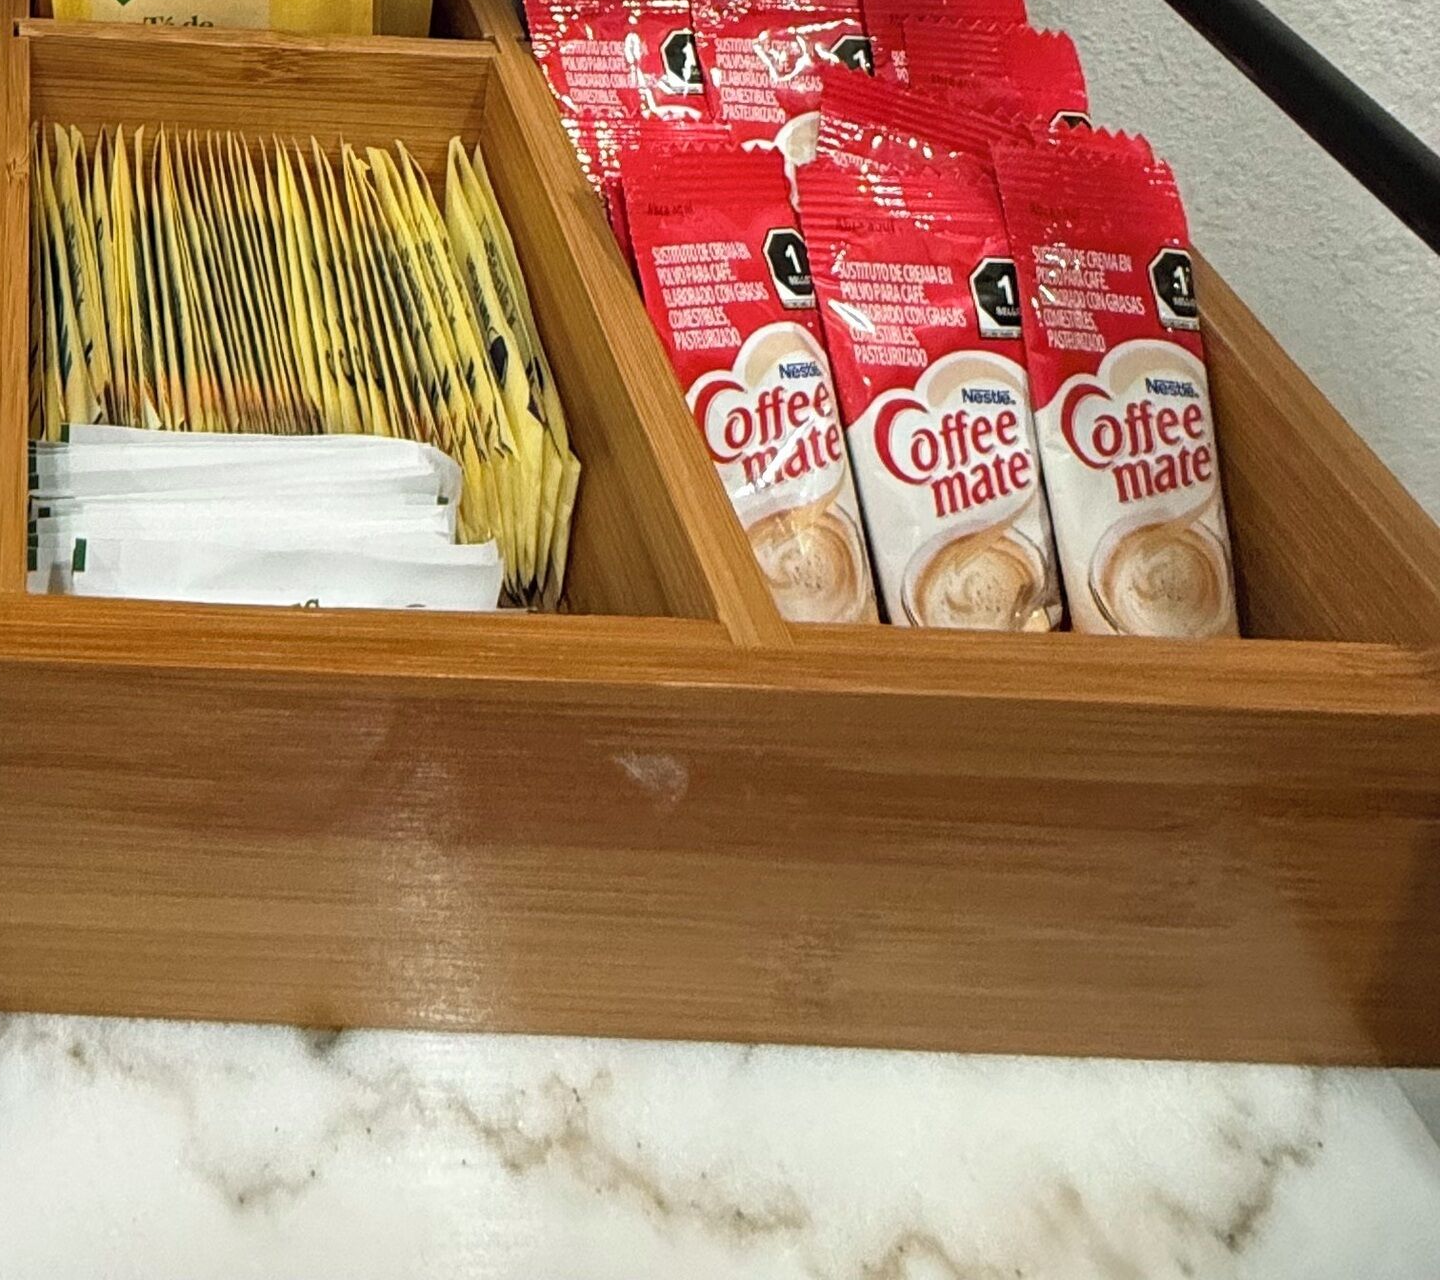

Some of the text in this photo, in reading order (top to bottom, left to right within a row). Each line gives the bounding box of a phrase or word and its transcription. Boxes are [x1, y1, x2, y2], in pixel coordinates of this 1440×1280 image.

[784, 243, 802, 274] 1
[997, 274, 1015, 306] 1
[1173, 266, 1189, 296] 1
[693, 380, 833, 465] Coffee
[874, 398, 1019, 485] Coffee
[1061, 383, 1205, 470] Coffee
[742, 423, 843, 490] mate
[930, 451, 1031, 518] mate
[1111, 444, 1212, 504] mate
